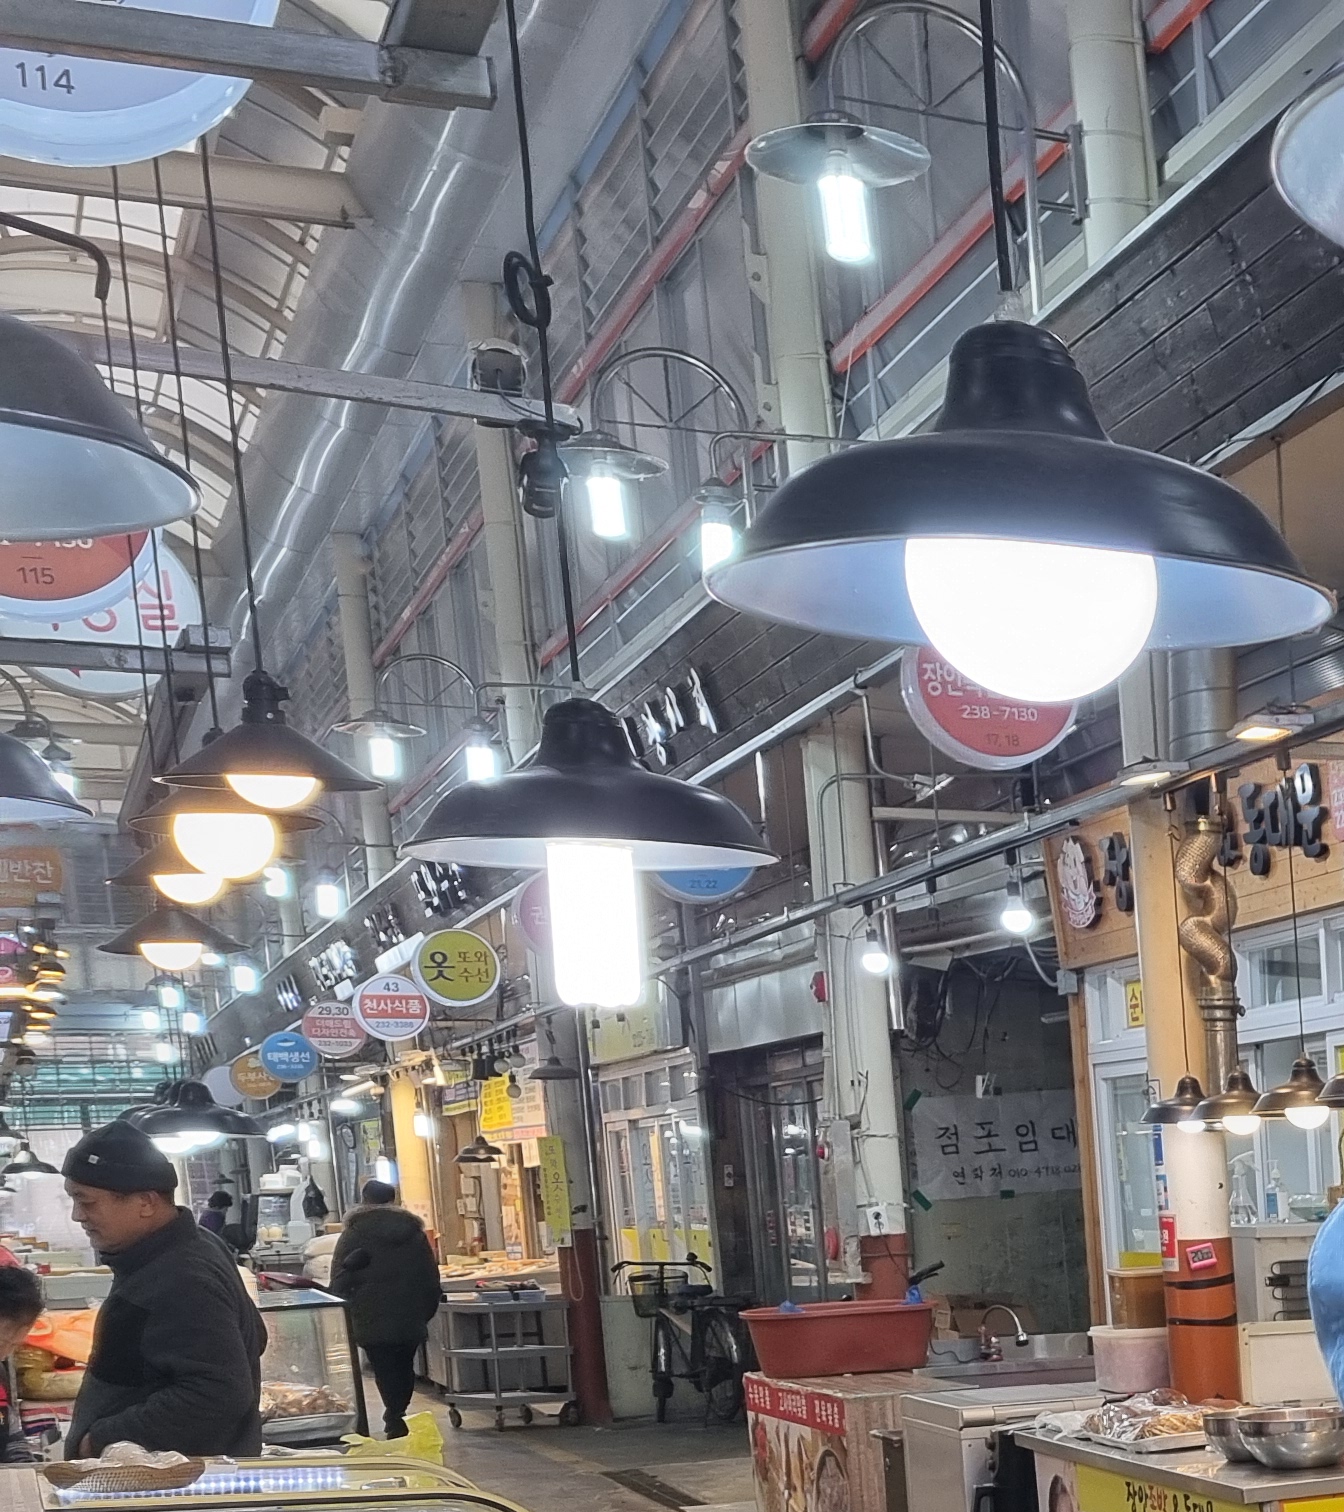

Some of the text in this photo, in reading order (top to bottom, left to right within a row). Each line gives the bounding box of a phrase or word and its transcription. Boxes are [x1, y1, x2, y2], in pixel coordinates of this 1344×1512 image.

[15, 62, 75, 95] 114
[16, 566, 55, 585] 115
[961, 705, 1038, 721] 238-7130
[424, 952, 455, 981] 옷
[459, 967, 490, 983] 수선
[384, 982, 400, 993] 43
[364, 999, 422, 1014] 천사식품
